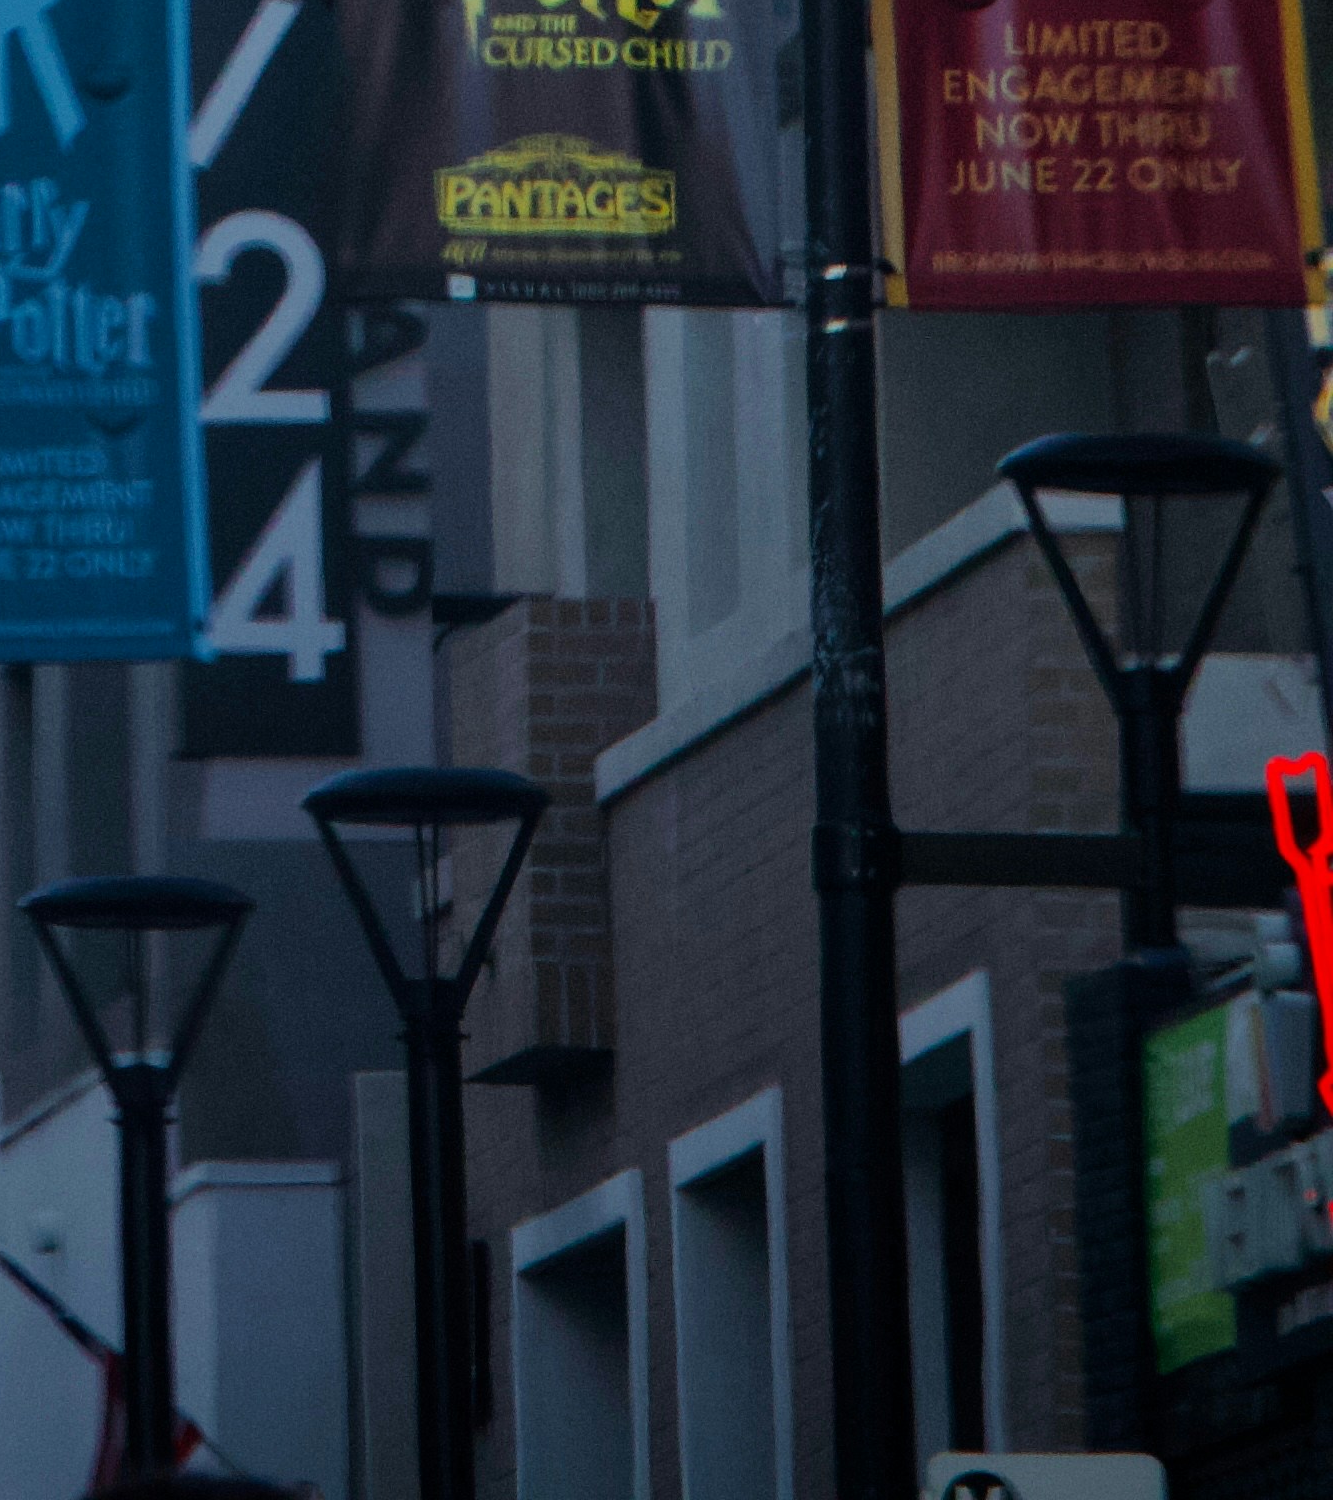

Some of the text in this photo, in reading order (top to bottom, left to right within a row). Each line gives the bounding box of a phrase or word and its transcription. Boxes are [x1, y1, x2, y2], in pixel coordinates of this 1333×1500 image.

[482, 36, 735, 71] CURSED CHILD
[1004, 20, 1171, 58] LIMITED
[942, 65, 1242, 104] ENGAGEMENT
[976, 110, 1211, 149] NOW THRU
[949, 156, 1243, 195] JUNE 22 ONLY
[443, 174, 673, 220] PANTAGES
